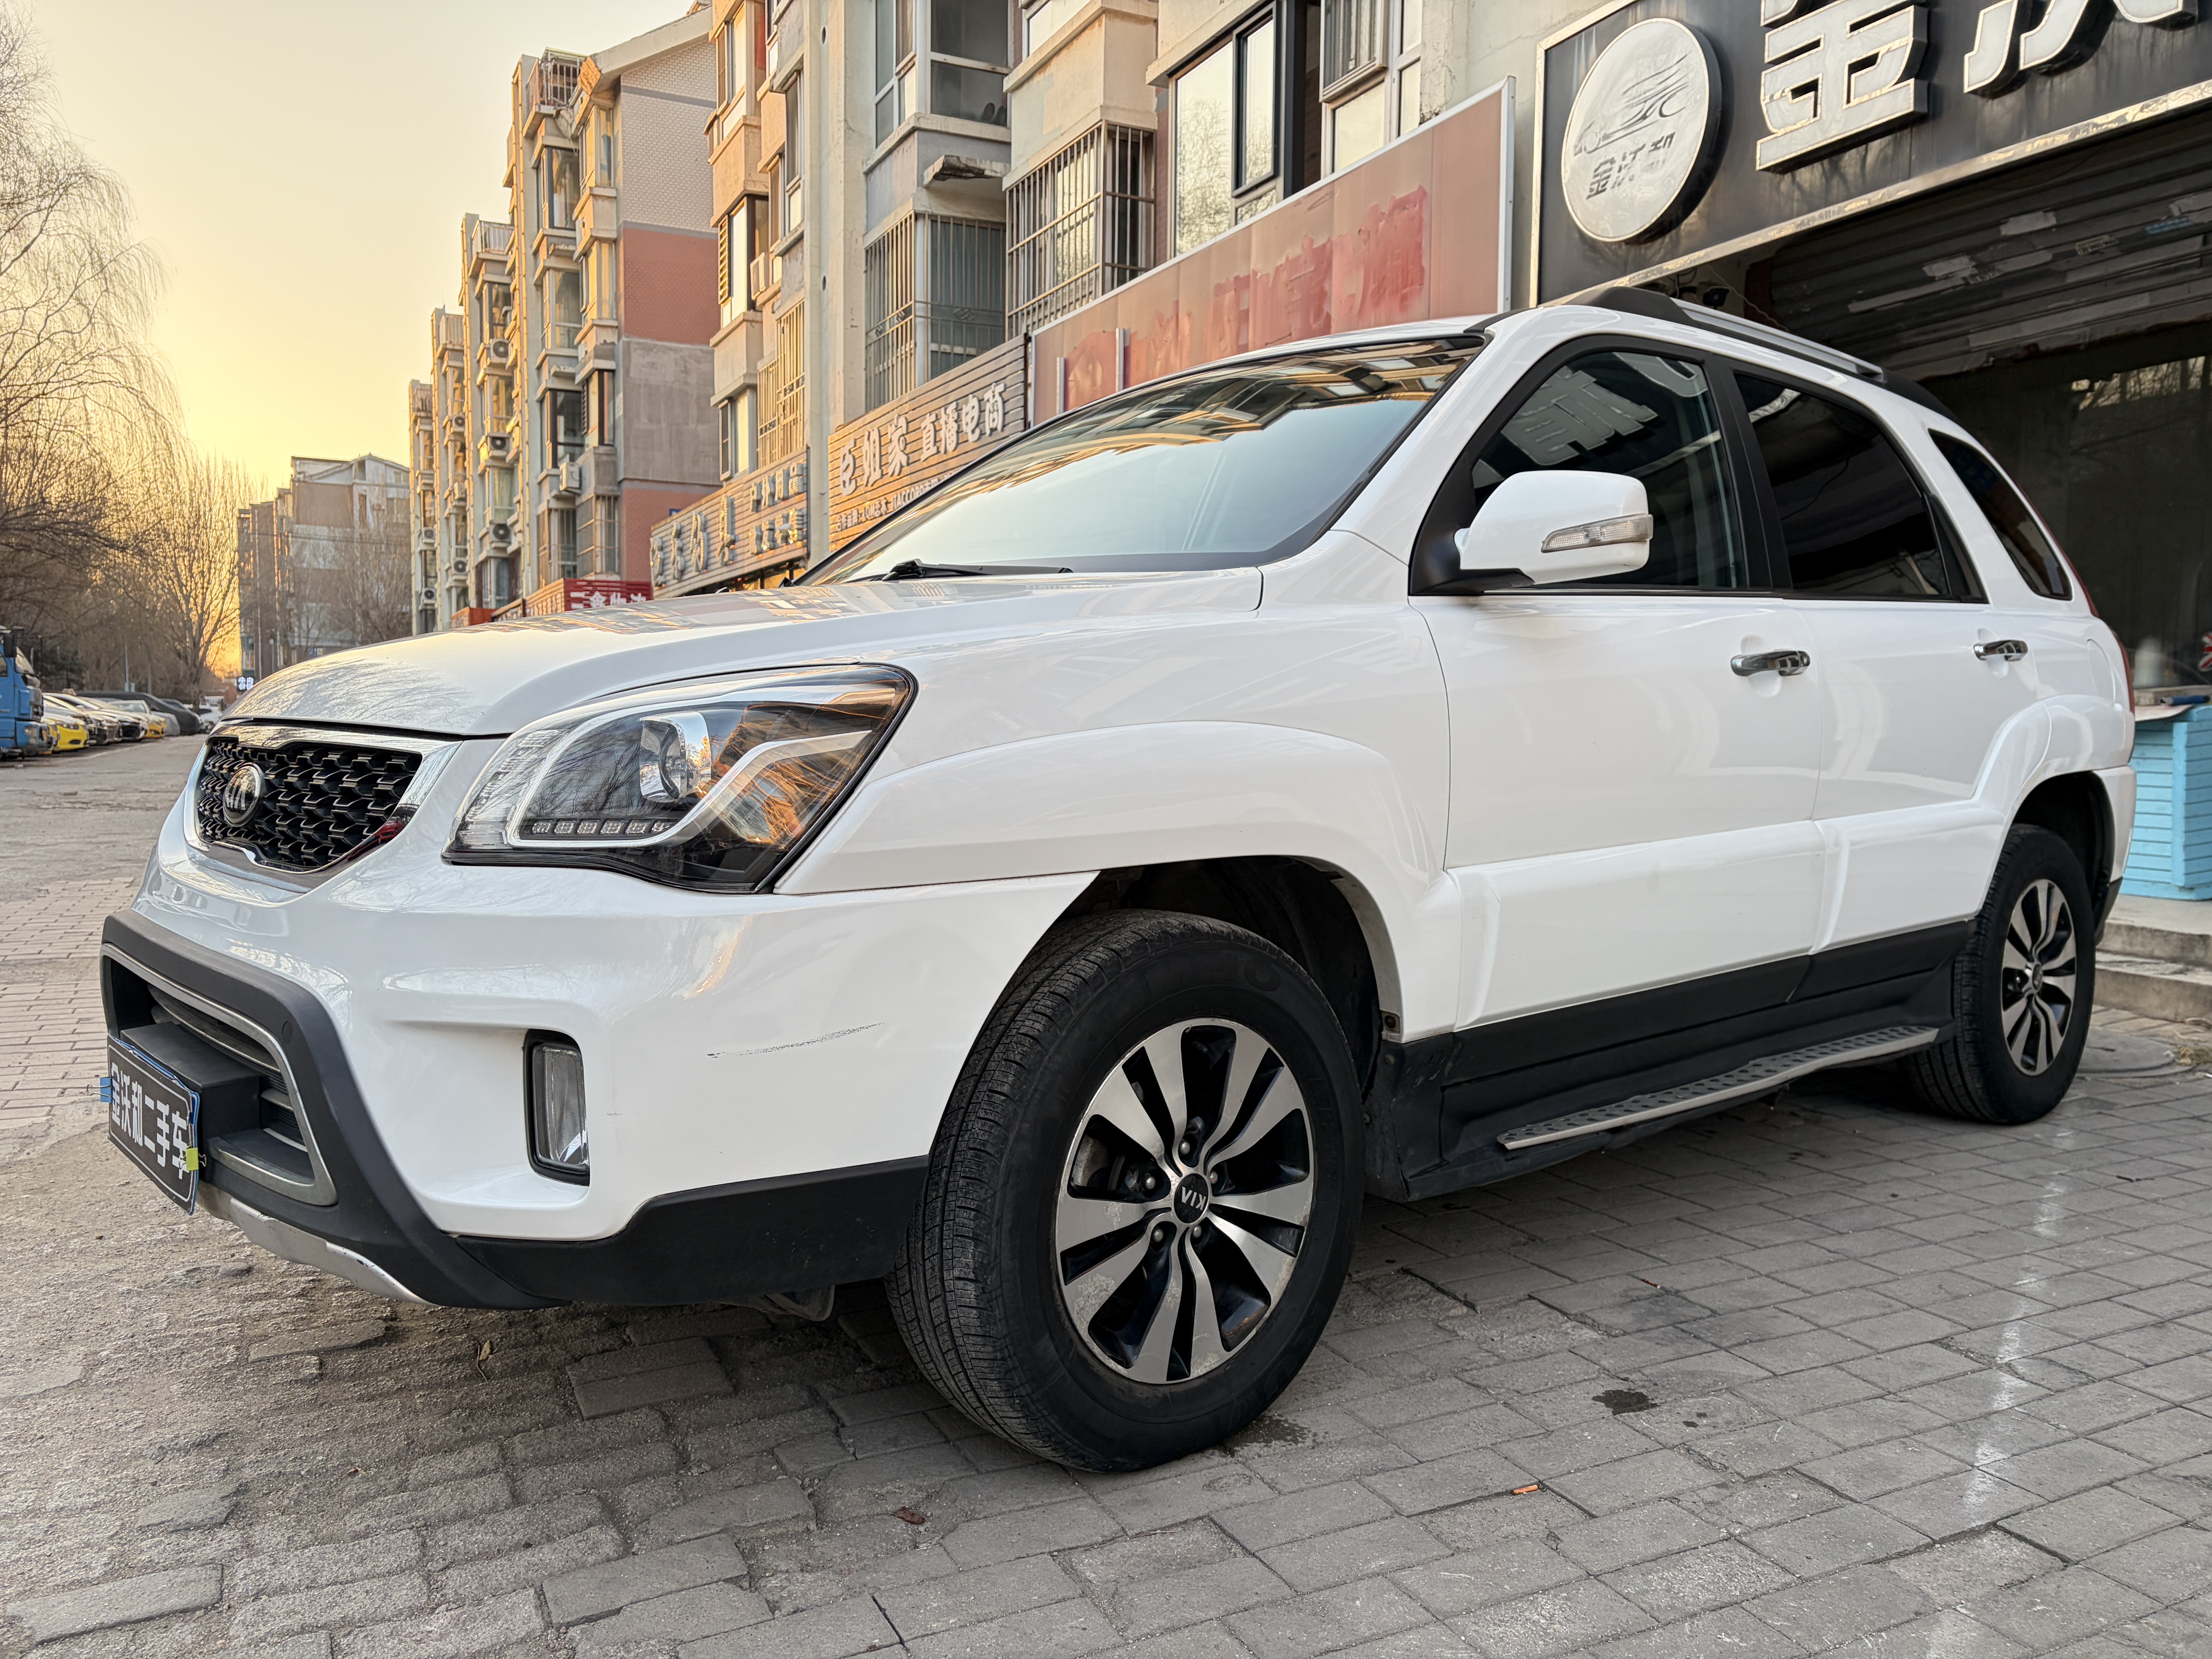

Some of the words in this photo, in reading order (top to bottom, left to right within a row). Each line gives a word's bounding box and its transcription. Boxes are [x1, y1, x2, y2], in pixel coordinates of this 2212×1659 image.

[921, 383, 1006, 462] 直播电商
[112, 1062, 189, 1180] 金沃和二手车
[1182, 1186, 1206, 1211] KIA
